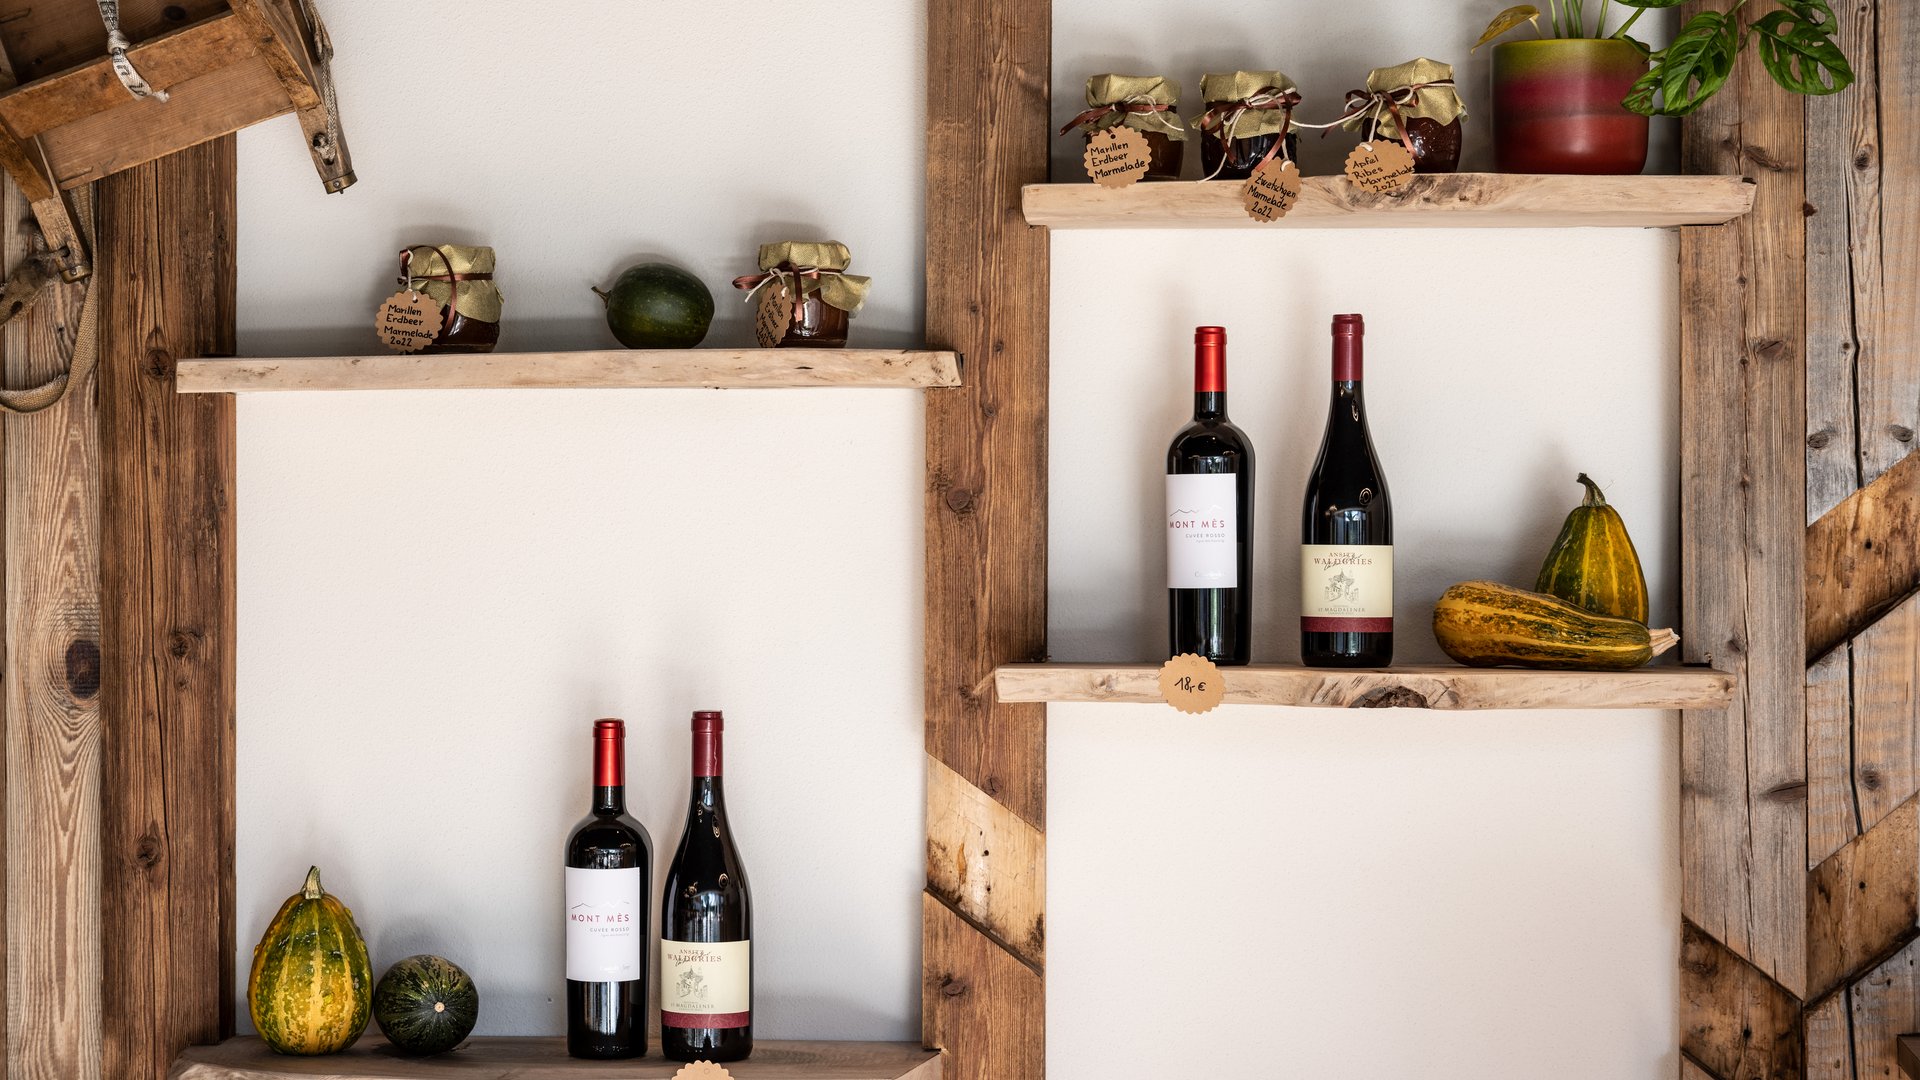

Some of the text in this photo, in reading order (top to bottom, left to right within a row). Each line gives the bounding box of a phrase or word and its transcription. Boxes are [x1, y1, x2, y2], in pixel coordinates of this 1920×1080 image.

[1090, 142, 1129, 156] Marillen
[1091, 152, 1128, 167] Erdbeer
[1352, 154, 1379, 169] Apfel
[1094, 158, 1145, 179] Marmelade
[1351, 167, 1383, 180] Ribes
[1254, 171, 1297, 199] Zwetschgen
[1372, 179, 1401, 192] 2022
[1246, 184, 1287, 210] Marmelade
[1251, 200, 1273, 218] 2022
[387, 304, 422, 316] Marillen
[386, 313, 424, 326] Erdbeer
[383, 325, 434, 339] Marmelade
[389, 336, 413, 347] 2022
[1169, 520, 1195, 529] MONT
[571, 914, 600, 922] MONT
